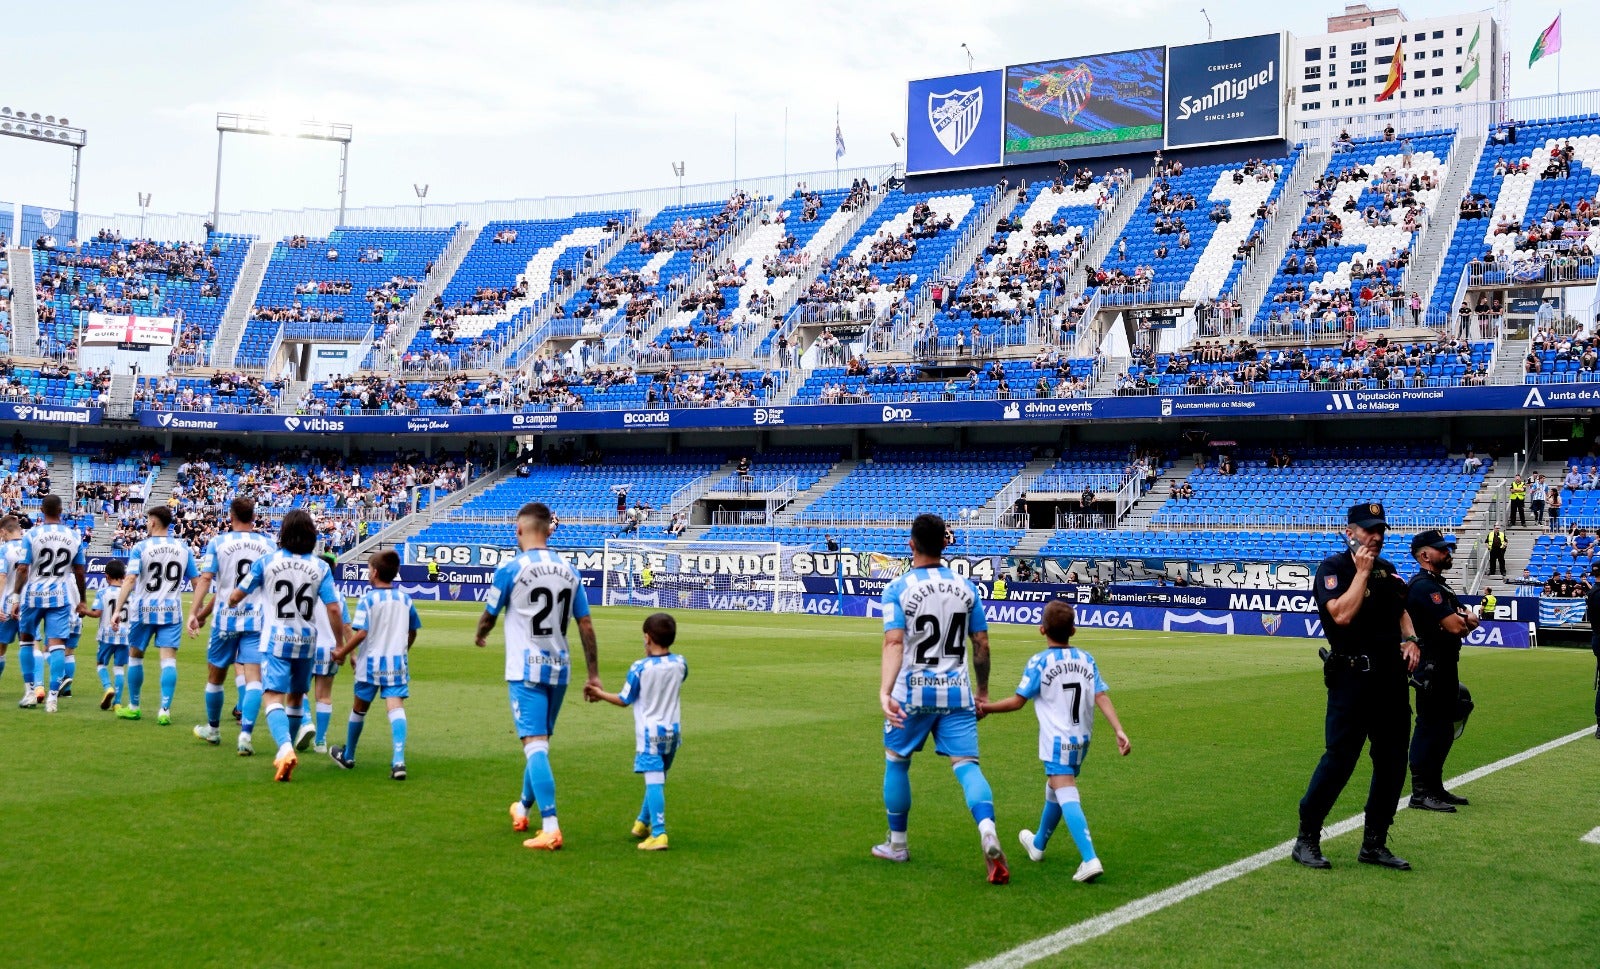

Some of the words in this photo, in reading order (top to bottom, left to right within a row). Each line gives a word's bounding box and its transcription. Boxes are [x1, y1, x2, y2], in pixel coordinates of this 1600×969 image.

[1208, 62, 1242, 72] CERVEZAS
[1226, 111, 1245, 119] 1890
[1357, 391, 1400, 402] Diputación
[1402, 390, 1443, 399] Provincial
[1547, 391, 1576, 400] Junta
[1578, 390, 1590, 399] de
[1025, 402, 1056, 412] divina
[1057, 400, 1092, 411] events
[1175, 401, 1219, 410] Ayuntamiento
[1221, 401, 1230, 409] de
[1357, 402, 1368, 410] de
[1369, 401, 1399, 412] Málaga
[33, 407, 90, 423] hummel
[525, 415, 557, 425] campano
[632, 411, 669, 423] coanda
[172, 418, 218, 429] Sanamar
[303, 418, 344, 431] vithas
[148, 547, 180, 557] CRISTIAN
[224, 543, 242, 556] LUIS
[37, 547, 72, 577] 22
[416, 545, 471, 565] LOS
[562, 550, 666, 574] EMPRE
[680, 553, 781, 577] FONDO
[792, 552, 860, 577] SUR
[941, 557, 994, 581] 04
[146, 560, 183, 594] 39
[449, 571, 482, 583] Garum
[530, 565, 576, 585] VILLALBA
[859, 580, 888, 590] Diputa
[274, 579, 314, 622] 26
[707, 594, 767, 611] VAMOS
[1173, 594, 1207, 606] Málaga
[1229, 593, 1320, 613] MALAGA
[529, 587, 572, 637] 21
[1071, 605, 1134, 628] ÁLAGA
[914, 612, 967, 666] 24
[1041, 664, 1063, 687] LAGO
[1063, 662, 1095, 682] JUNIOR
[1062, 682, 1082, 724] 7
